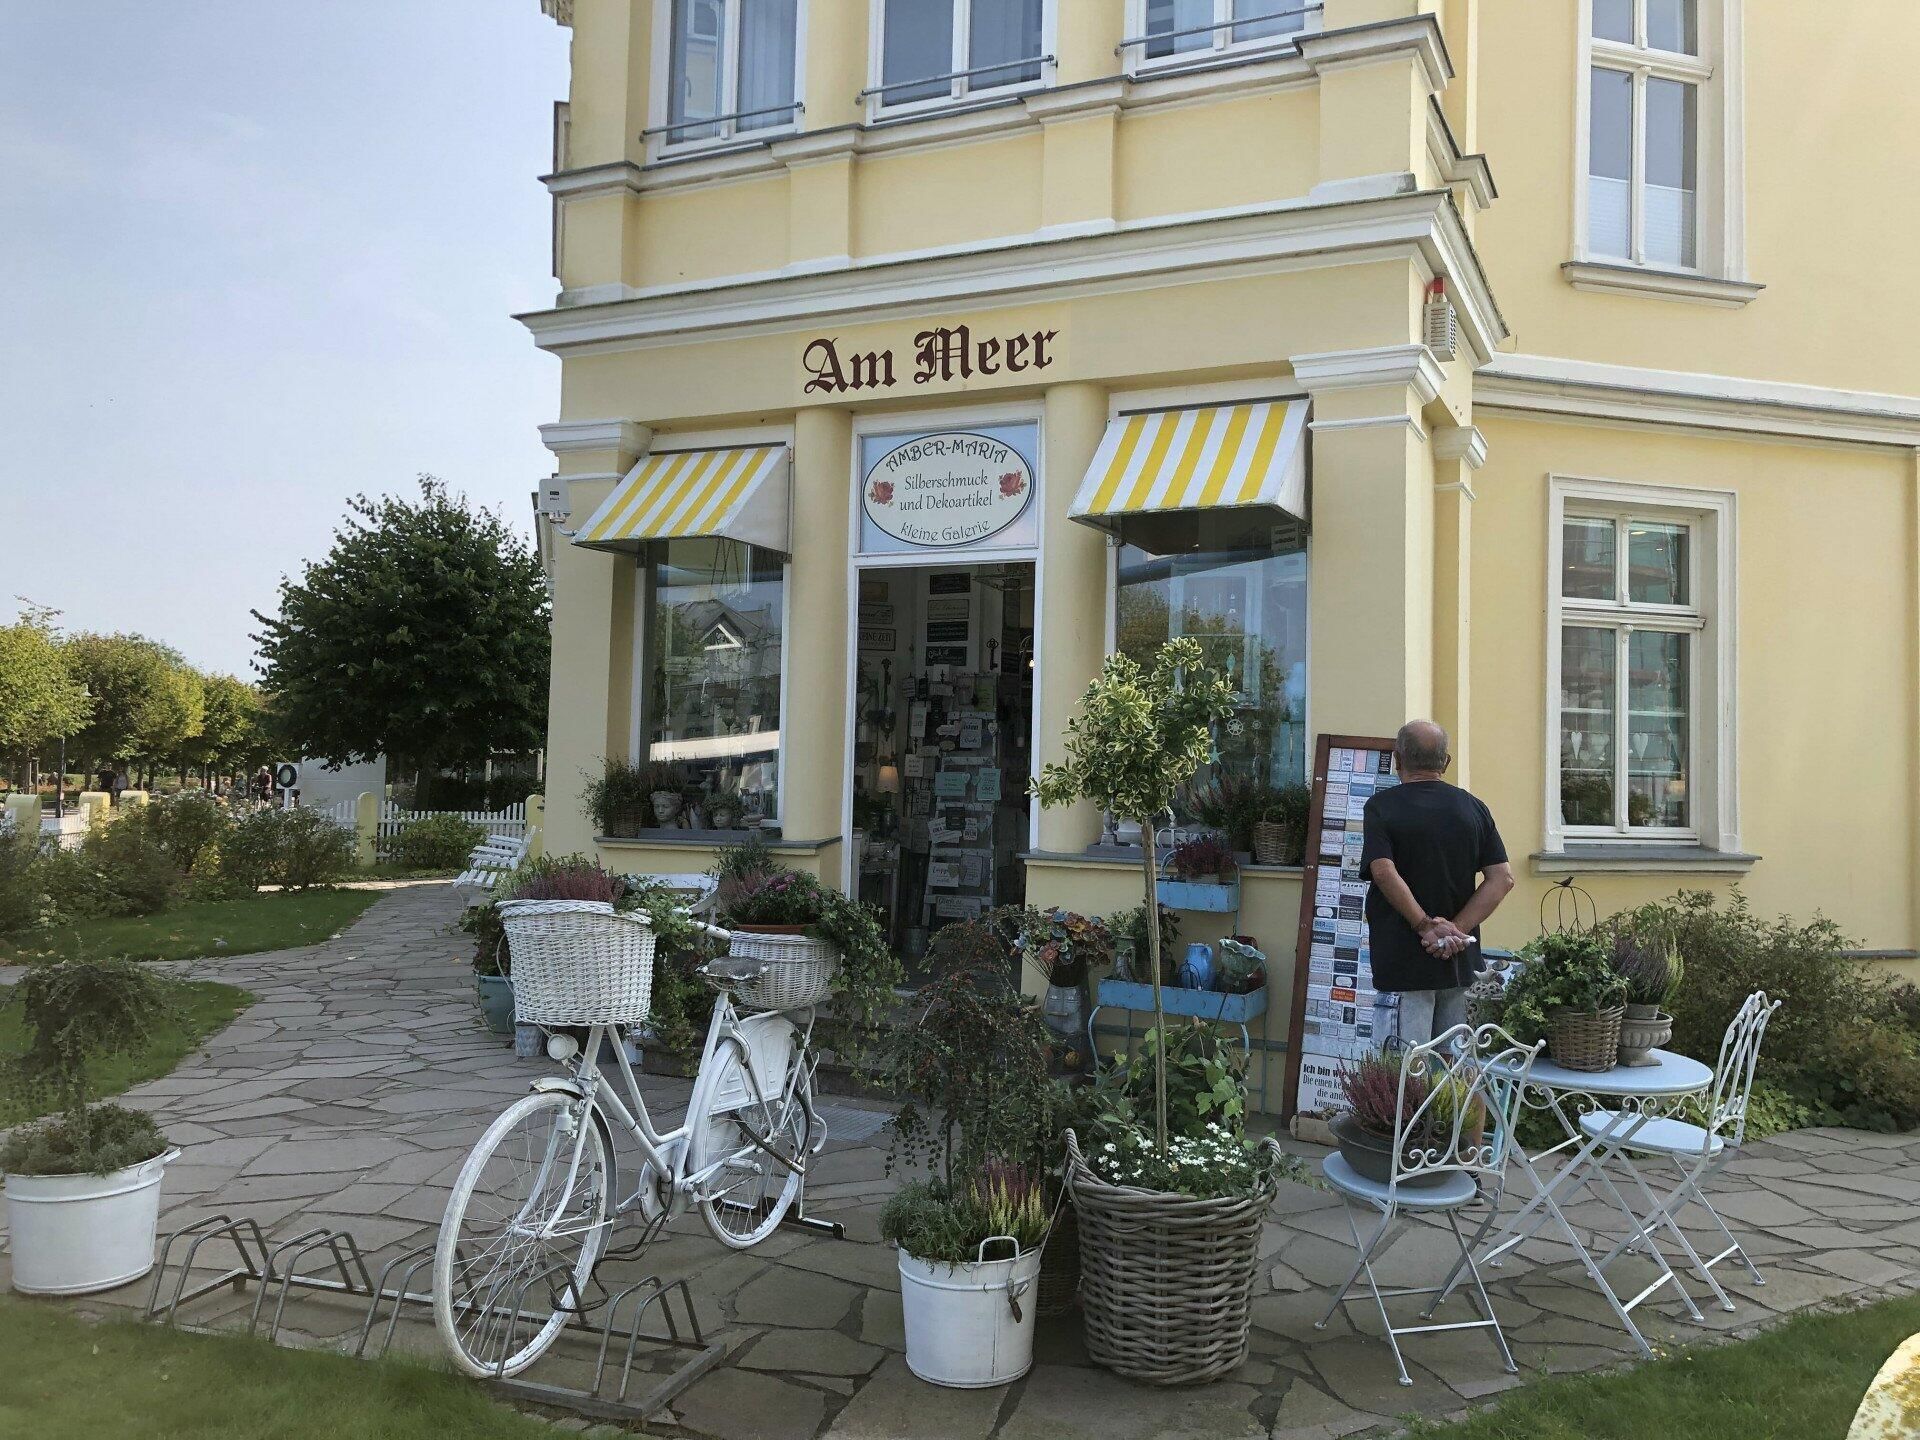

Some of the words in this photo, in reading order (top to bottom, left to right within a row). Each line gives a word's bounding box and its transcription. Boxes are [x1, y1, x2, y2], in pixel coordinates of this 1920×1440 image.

[803, 337, 897, 394] Am
[913, 324, 1060, 384] Meer
[886, 439, 1008, 472] AMBER-MARIA
[904, 469, 988, 490] Silberschmuck
[900, 496, 923, 511] und
[926, 490, 992, 510] Dekoartikel
[900, 521, 939, 542] kleine
[941, 520, 991, 541] Galerie
[1303, 1064, 1316, 1074] Ich
[1317, 1066, 1331, 1077] bin
[1303, 1074, 1314, 1085] Die
[1314, 1076, 1333, 1088] einen
[1317, 1088, 1328, 1098] die
